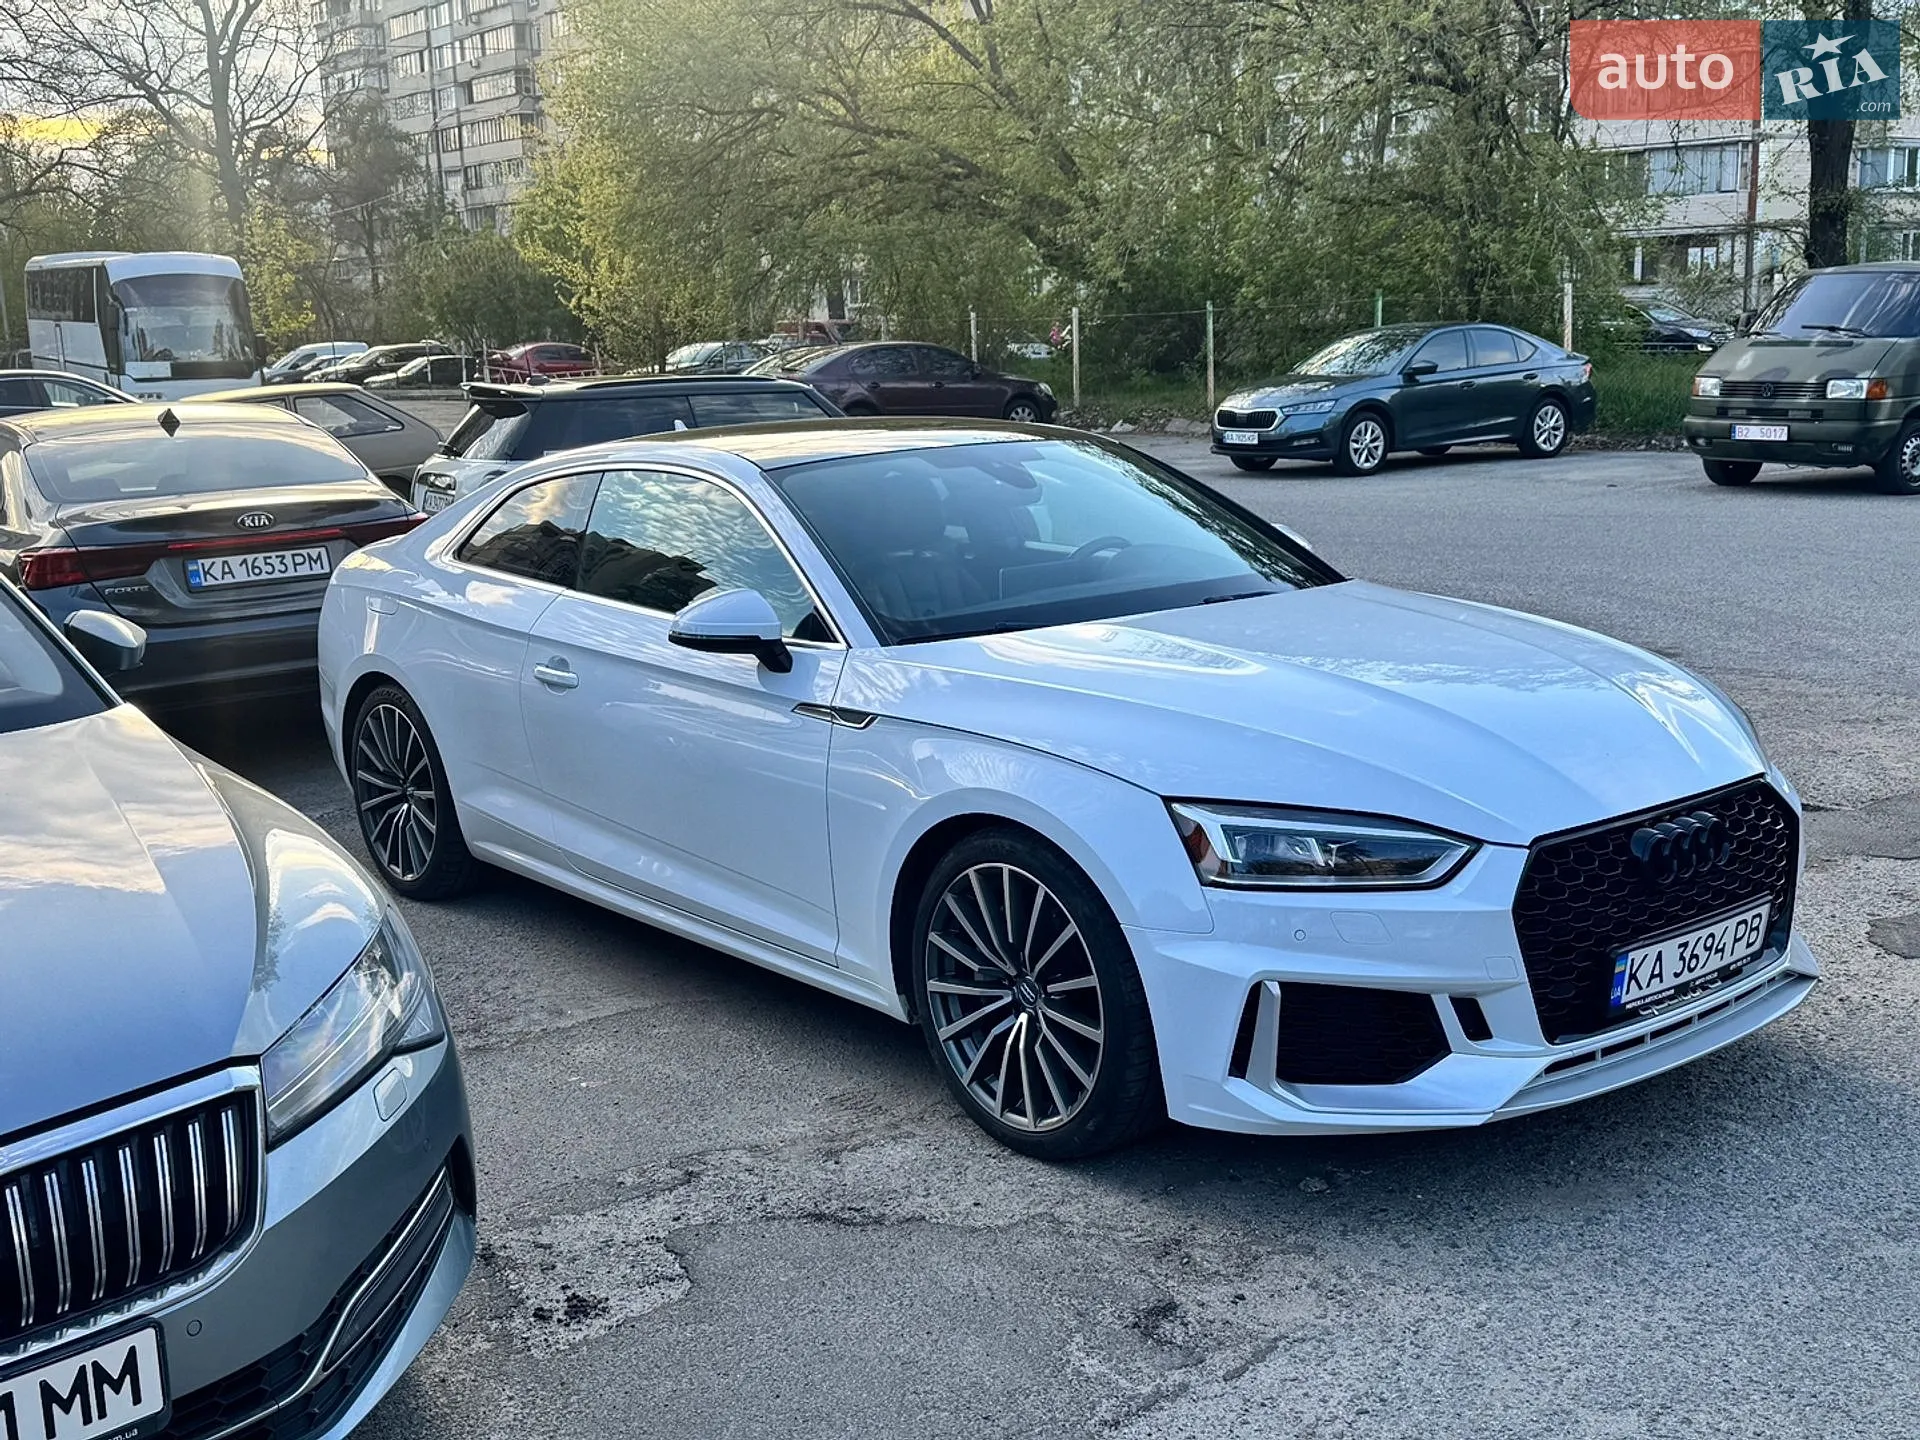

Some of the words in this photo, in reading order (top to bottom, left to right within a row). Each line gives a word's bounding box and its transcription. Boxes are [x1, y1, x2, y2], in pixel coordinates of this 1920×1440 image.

[243, 515, 270, 527] KIA
[201, 559, 236, 583] KA
[238, 554, 289, 578] 1653
[291, 550, 325, 573] PM
[1625, 949, 1664, 996] KA
[1673, 925, 1730, 979] 3694
[1730, 911, 1763, 957] PB
[39, 1345, 142, 1440] MM
